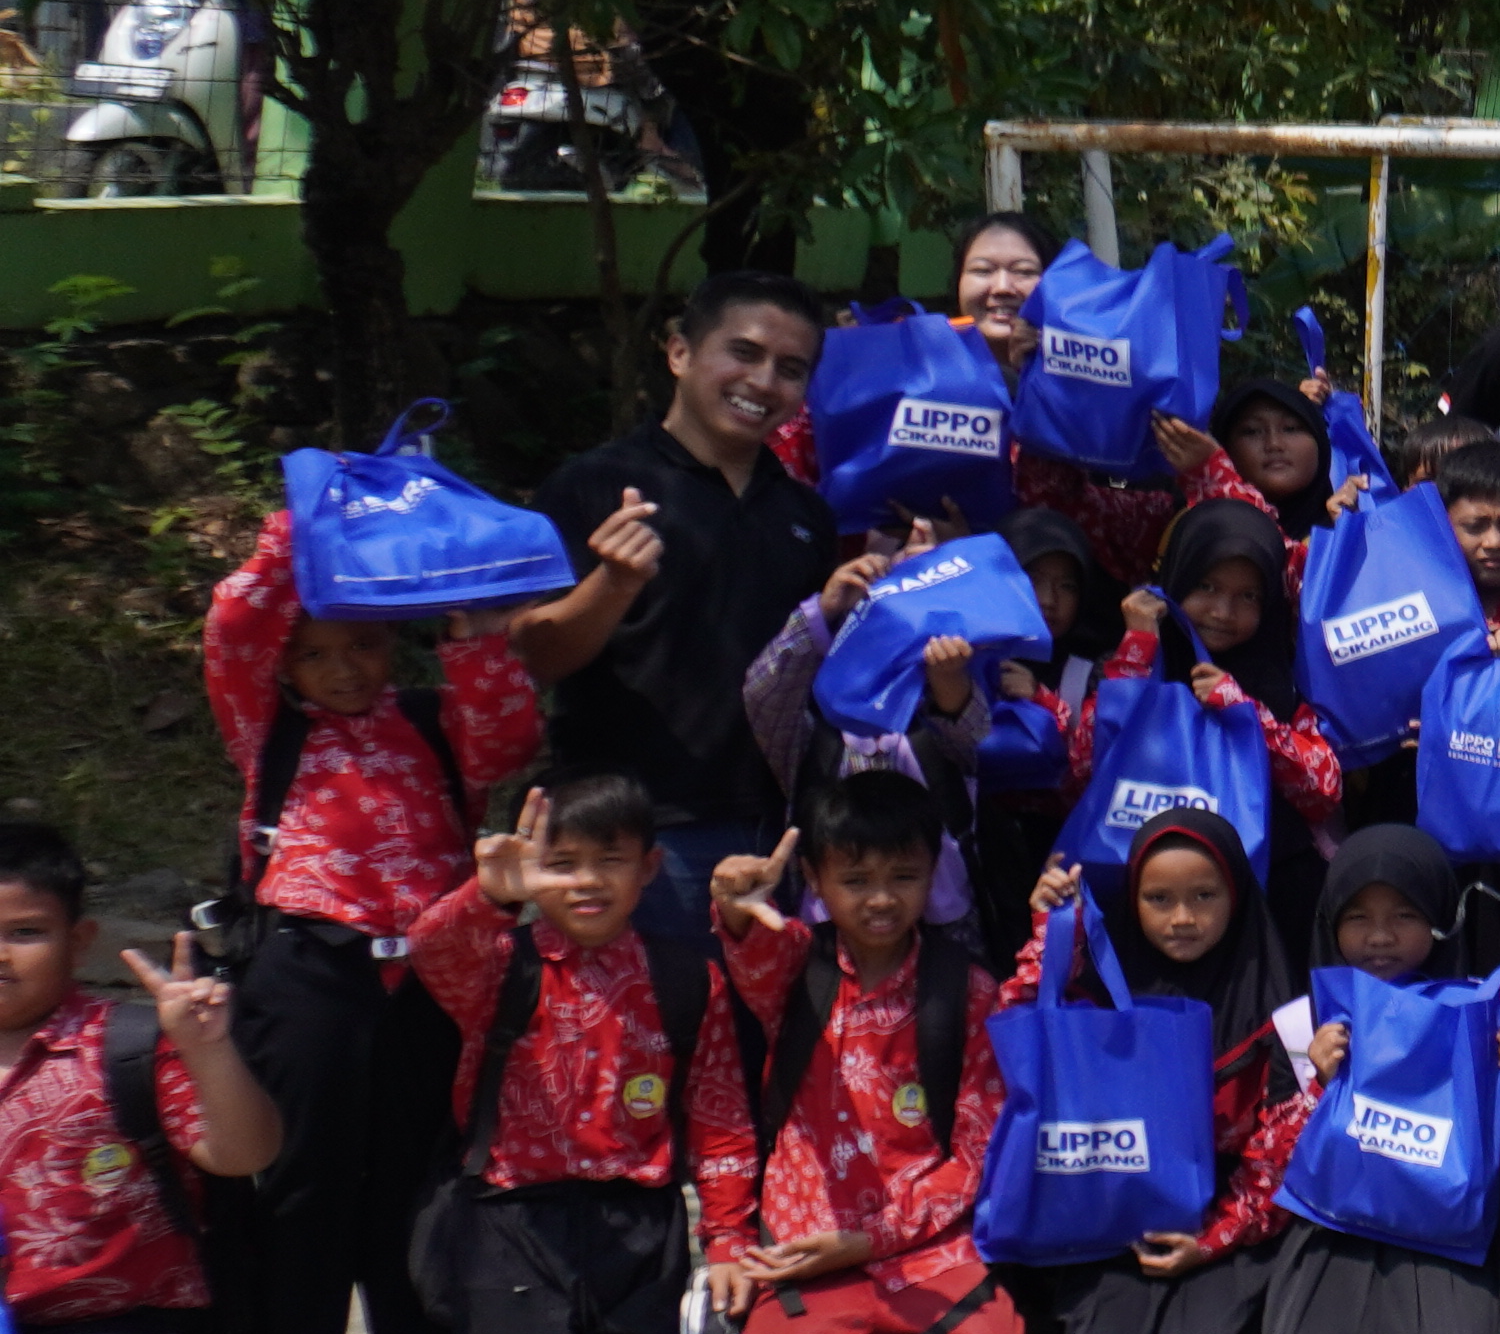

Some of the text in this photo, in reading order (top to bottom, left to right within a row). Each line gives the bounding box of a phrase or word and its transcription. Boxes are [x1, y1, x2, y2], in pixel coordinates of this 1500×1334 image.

[1050, 335, 1119, 367] LIPPO
[1046, 356, 1129, 383] CIKARANG
[903, 406, 991, 436] LIPPO
[893, 428, 996, 452] CIKARANG
[1333, 603, 1420, 644] LIPPO
[1333, 619, 1435, 661] CIKARANG
[1450, 729, 1496, 750] LIPPO
[1124, 788, 1210, 812] LIPPO
[1362, 1107, 1437, 1145] IPPO
[1040, 1130, 1137, 1153] LIPPO
[1037, 1153, 1145, 1169] CIKARANG
